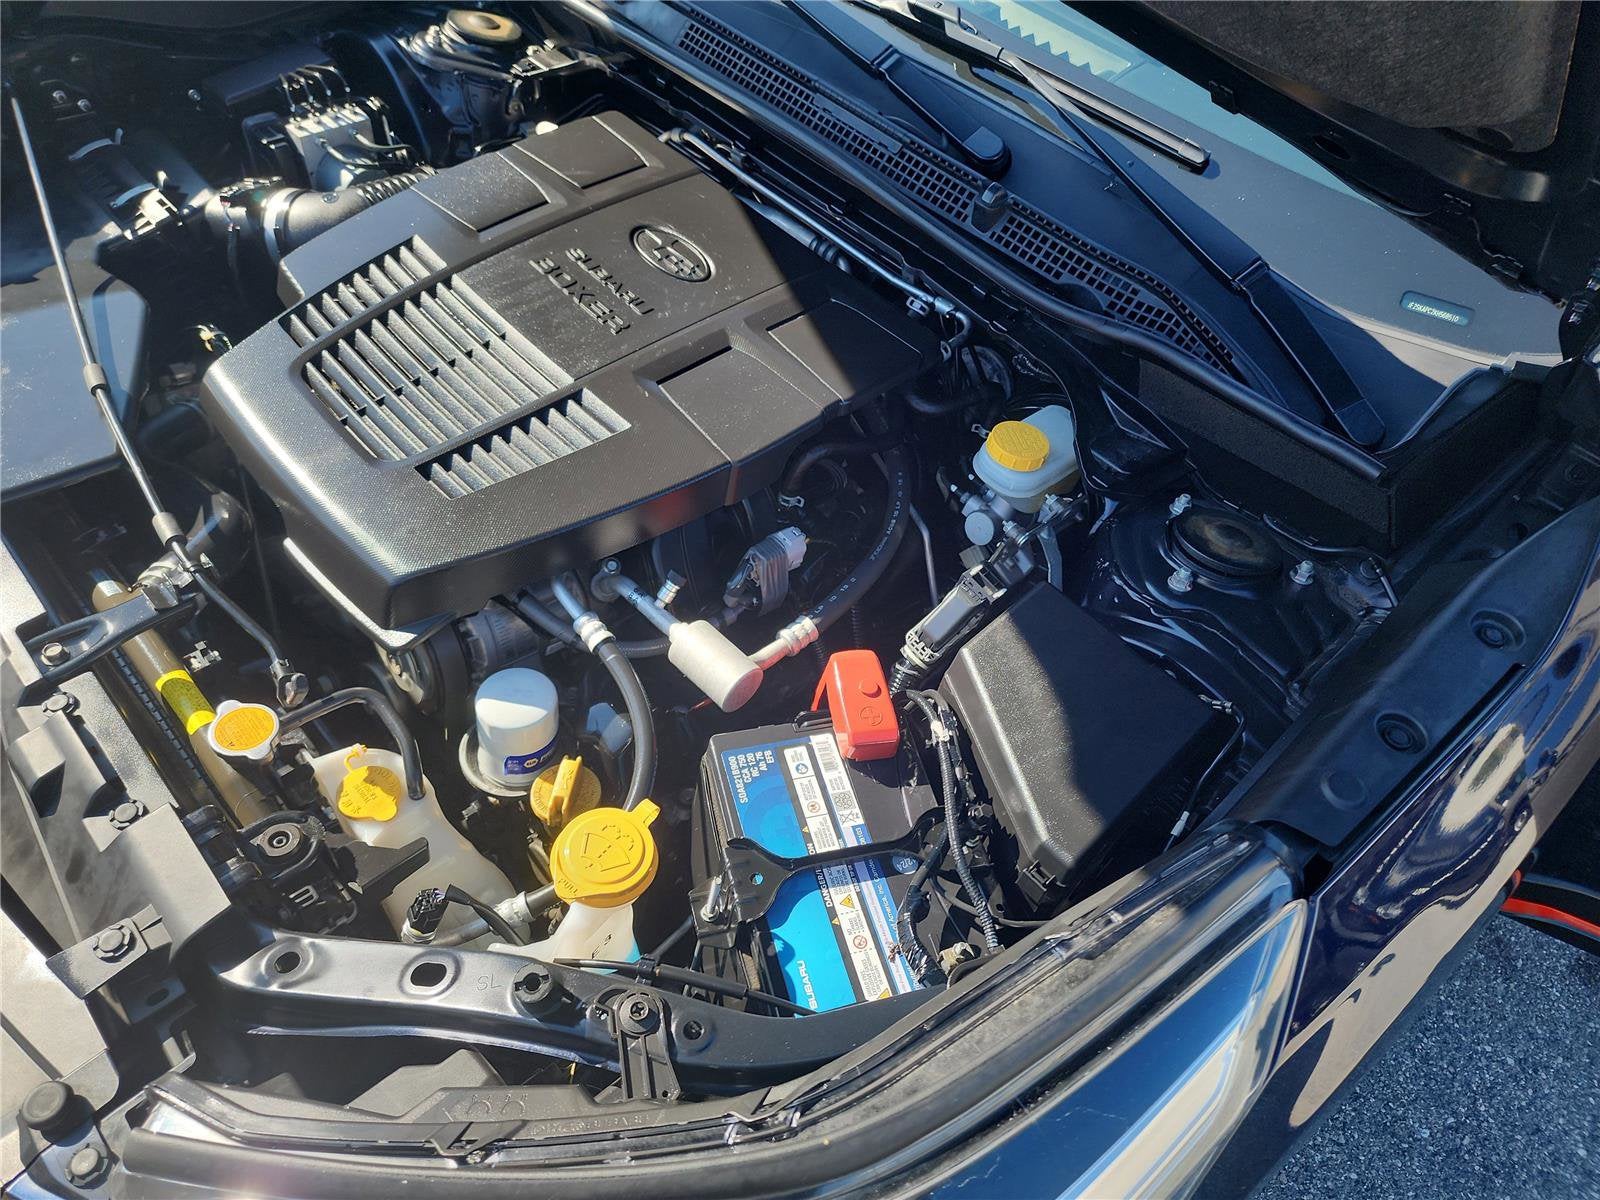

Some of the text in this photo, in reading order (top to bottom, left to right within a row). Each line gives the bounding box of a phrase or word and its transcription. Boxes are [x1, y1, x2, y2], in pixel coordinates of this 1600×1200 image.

[565, 248, 655, 315] SUBARU
[528, 257, 631, 336] BOXER
[737, 754, 752, 783] CCA 750
[746, 752, 760, 777] RC 120
[755, 751, 764, 761] 76
[764, 750, 774, 764] EFB
[797, 960, 818, 1010] SUBARU
